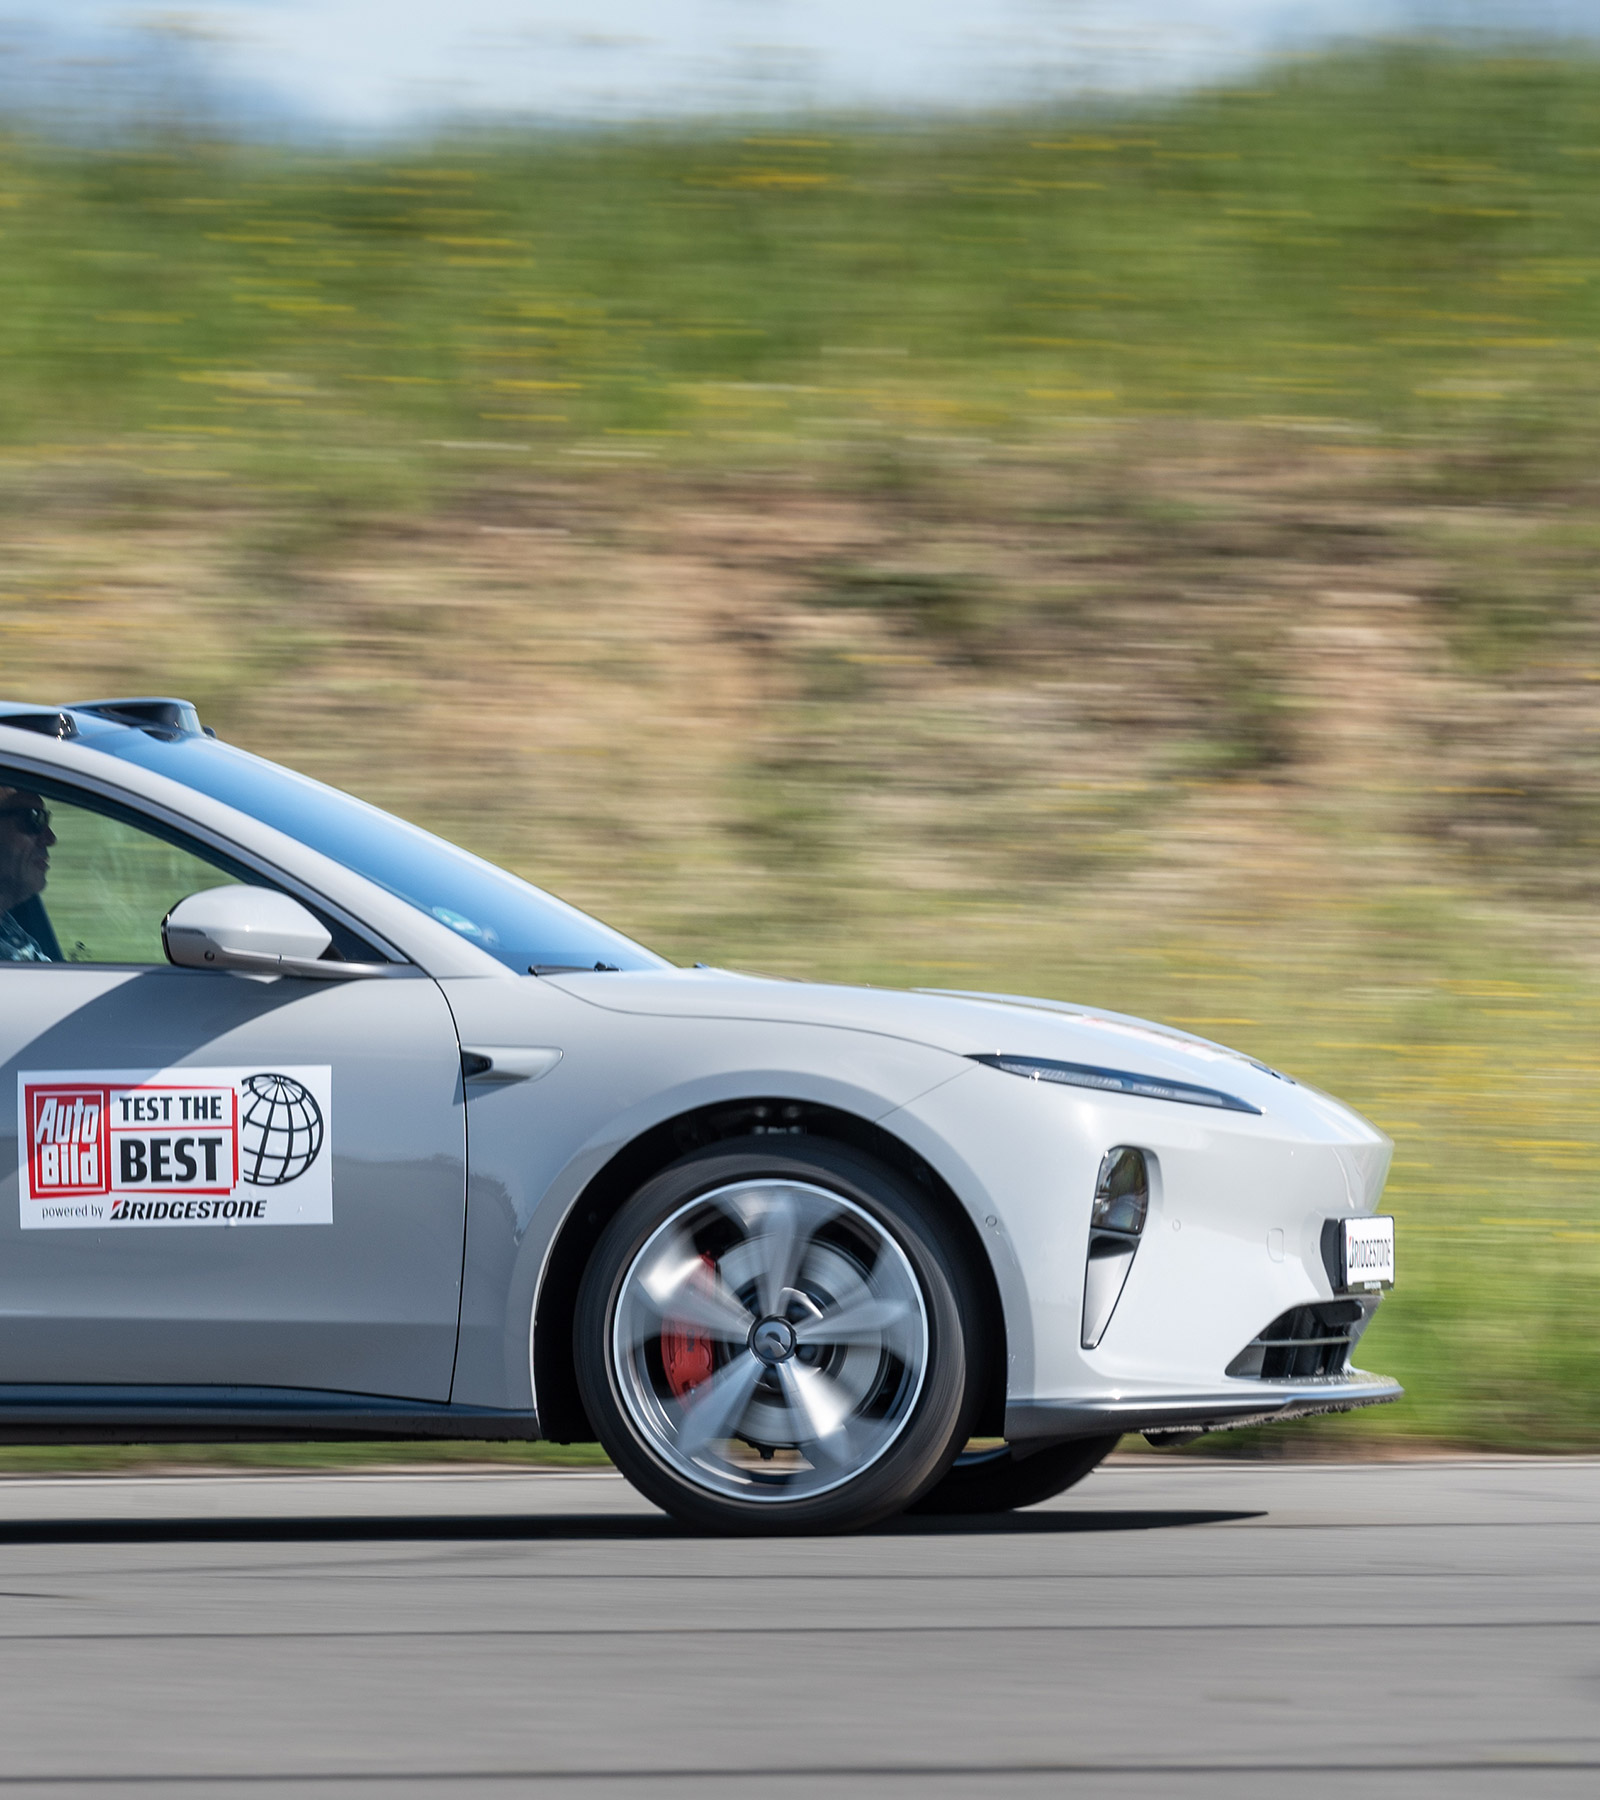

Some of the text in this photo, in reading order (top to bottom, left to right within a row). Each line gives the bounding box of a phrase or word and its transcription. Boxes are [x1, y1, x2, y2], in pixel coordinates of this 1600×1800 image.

[36, 1098, 99, 1144] Auto
[119, 1096, 222, 1122] TEST THE
[41, 1143, 99, 1185] Bild
[119, 1137, 222, 1183] BEST
[41, 1200, 268, 1220] powered by BRIDGESTONE
